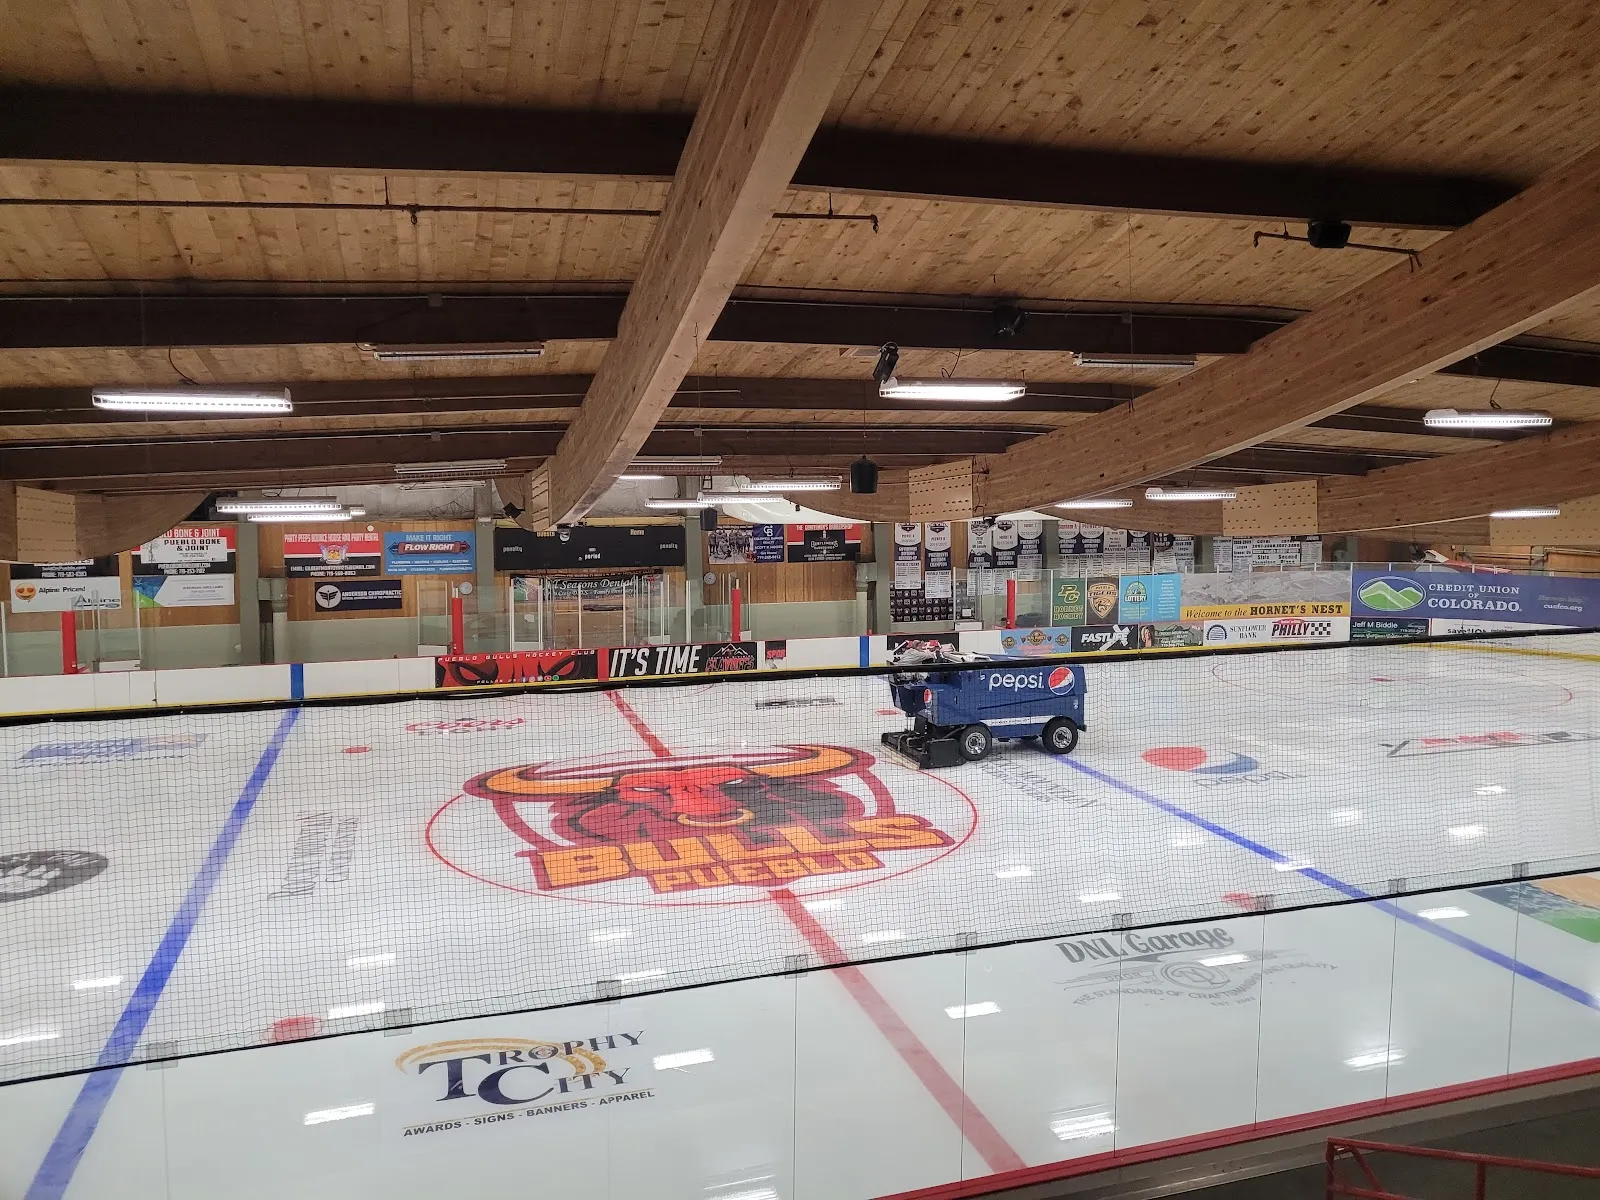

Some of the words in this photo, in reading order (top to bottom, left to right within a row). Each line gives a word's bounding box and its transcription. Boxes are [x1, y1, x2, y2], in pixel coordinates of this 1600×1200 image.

[174, 529, 192, 538] BONE
[200, 528, 220, 538] JOINT
[284, 534, 298, 542] PARTY
[298, 534, 310, 542] PEEPS
[328, 533, 342, 542] HOUSE
[350, 533, 364, 541] PARTY
[560, 579, 598, 590] Seasons
[600, 576, 634, 588] Dental
[1428, 583, 1475, 592] CREDIT
[1479, 586, 1520, 594] UNION
[1186, 608, 1221, 618] Welcome
[1224, 609, 1234, 617] to
[1236, 608, 1248, 616] the
[1250, 605, 1306, 616] HORNET'S
[1312, 604, 1343, 614] NEST
[1428, 598, 1520, 612] COLORADO
[1081, 632, 1128, 643] FASTLIFE
[1272, 622, 1310, 637] PHILLY
[610, 648, 650, 678] IT'S
[655, 646, 702, 675] TIME
[988, 671, 1044, 692] pepsi
[537, 810, 950, 889] BULLS
[652, 850, 882, 893] PUEBLO
[1056, 937, 1127, 964] DNL
[1126, 926, 1235, 952] Garage
[1072, 994, 1096, 1005] THE
[1093, 988, 1164, 998] STANDARD
[1282, 962, 1338, 970] QUALITY
[418, 1030, 646, 1102] TROPHY
[477, 1063, 632, 1106] CITY
[403, 1121, 462, 1137] AWARDS
[474, 1112, 514, 1126] SIGNS
[526, 1100, 588, 1118] BANNERS
[599, 1090, 656, 1106] APPAREL
